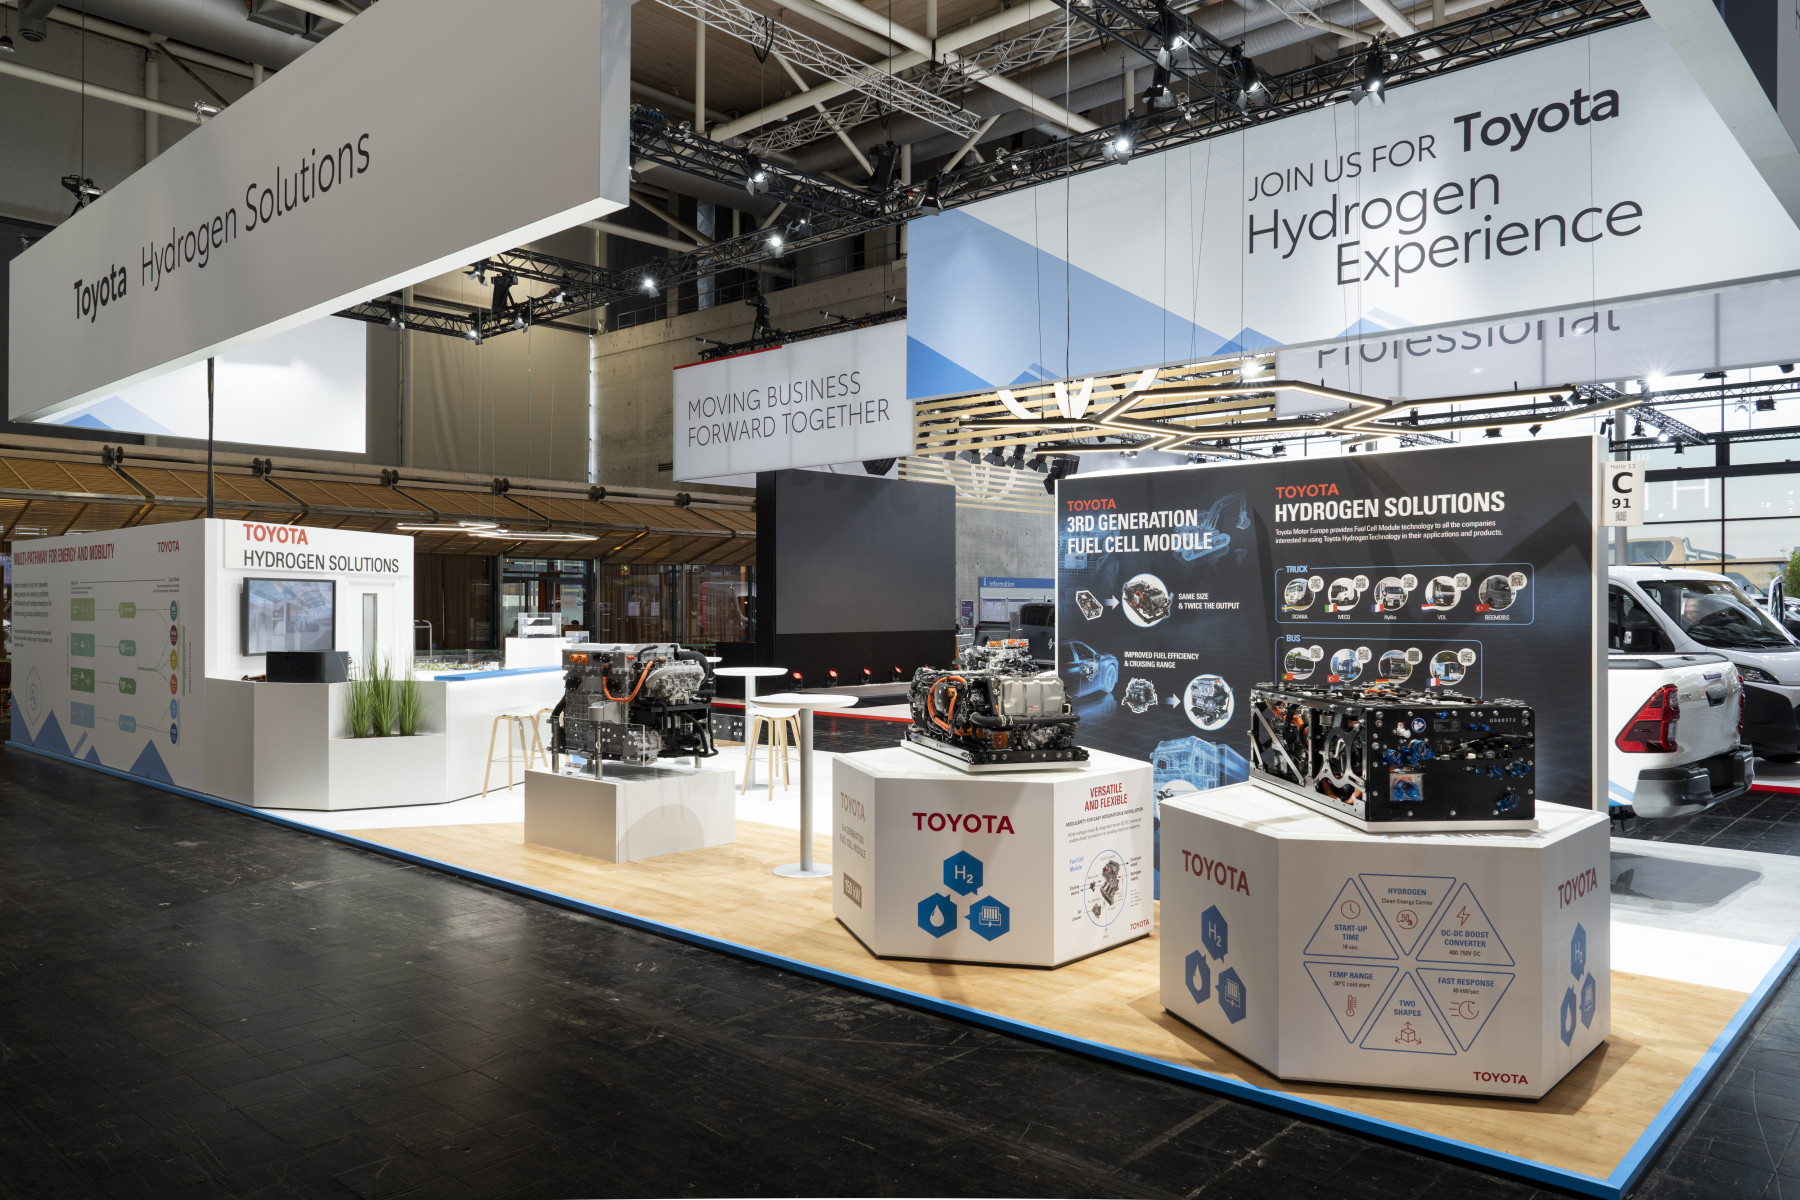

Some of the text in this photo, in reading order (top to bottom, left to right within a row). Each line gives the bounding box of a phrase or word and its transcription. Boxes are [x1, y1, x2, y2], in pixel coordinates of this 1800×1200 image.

[1453, 88, 1619, 153] Toyota
[1248, 134, 1436, 202] JOIN US FOR
[1248, 173, 1500, 259] Hydrogen
[74, 132, 370, 323] Toyota Hydrogen Solutions
[1337, 200, 1643, 287] Experience
[688, 371, 861, 421] MOVING BUSINESS
[688, 399, 890, 448] FORWARD TOGETHER
[1612, 471, 1633, 494] C
[1275, 483, 1340, 499] TOYOTA
[1067, 498, 1117, 512] TOYOTA
[1275, 491, 1505, 522] HYDROGEN SOLUTIONS
[1612, 498, 1632, 509] 91
[1067, 509, 1198, 533] 3RD GENERATION
[1275, 528, 1292, 536] Toyota
[1310, 527, 1329, 535] Europe
[1329, 526, 1353, 534] provides
[1401, 523, 1434, 531] technology
[1461, 520, 1496, 529] companies
[243, 523, 309, 545] TOYOTA
[1275, 536, 1302, 544] interested
[1342, 534, 1368, 543] Hydrogen
[1369, 533, 1401, 542] Technology
[1422, 530, 1459, 540] applications
[1473, 528, 1503, 538] products.
[157, 541, 180, 552] TOYOTA
[1067, 532, 1213, 554] FUEL CELL MODULE
[14, 551, 48, 566] MULTI-PATHWAY
[48, 549, 57, 563] FOR
[58, 547, 77, 562] ENERGY
[78, 545, 88, 561] AND
[89, 543, 115, 560] MOBILITY
[244, 550, 399, 573] HYDROGEN SOLUTIONS
[1286, 565, 1308, 573] TRUCK
[1195, 592, 1209, 600] SIZE
[1184, 602, 1203, 610] TWICE
[1204, 602, 1215, 610] THE
[1215, 602, 1240, 610] OUTPUT
[1286, 634, 1301, 642] BUS
[1124, 651, 1153, 659] IMPROVED
[1167, 652, 1199, 660] EFFICIENCY
[1156, 661, 1176, 669] RANGE
[1090, 783, 1123, 798] VERSATILE
[840, 792, 866, 822] TOYOTA
[1084, 794, 1128, 812] AND FLEXIBLE
[912, 812, 1015, 835] TOYOTA
[1066, 818, 1086, 827] MODULARITY
[1101, 812, 1121, 820] INTEGRATION
[1124, 807, 1144, 815] INSTALLATION
[846, 826, 864, 845] GENERATION
[854, 842, 866, 859] MODULE
[1182, 849, 1250, 896] TOYOTA
[1387, 888, 1427, 896] HYDROGEN
[1557, 866, 1598, 909] TOYOTA
[1130, 919, 1150, 930] TOYOTA
[1334, 924, 1368, 932] START-UP
[1441, 929, 1464, 937] DC-DC
[1444, 939, 1486, 947] CONVERTER
[1349, 972, 1374, 980] RANGE
[1438, 977, 1495, 987] FAST RESPONSE
[1393, 1009, 1422, 1017] SHAPES
[1472, 1071, 1529, 1085] TOYOTA
